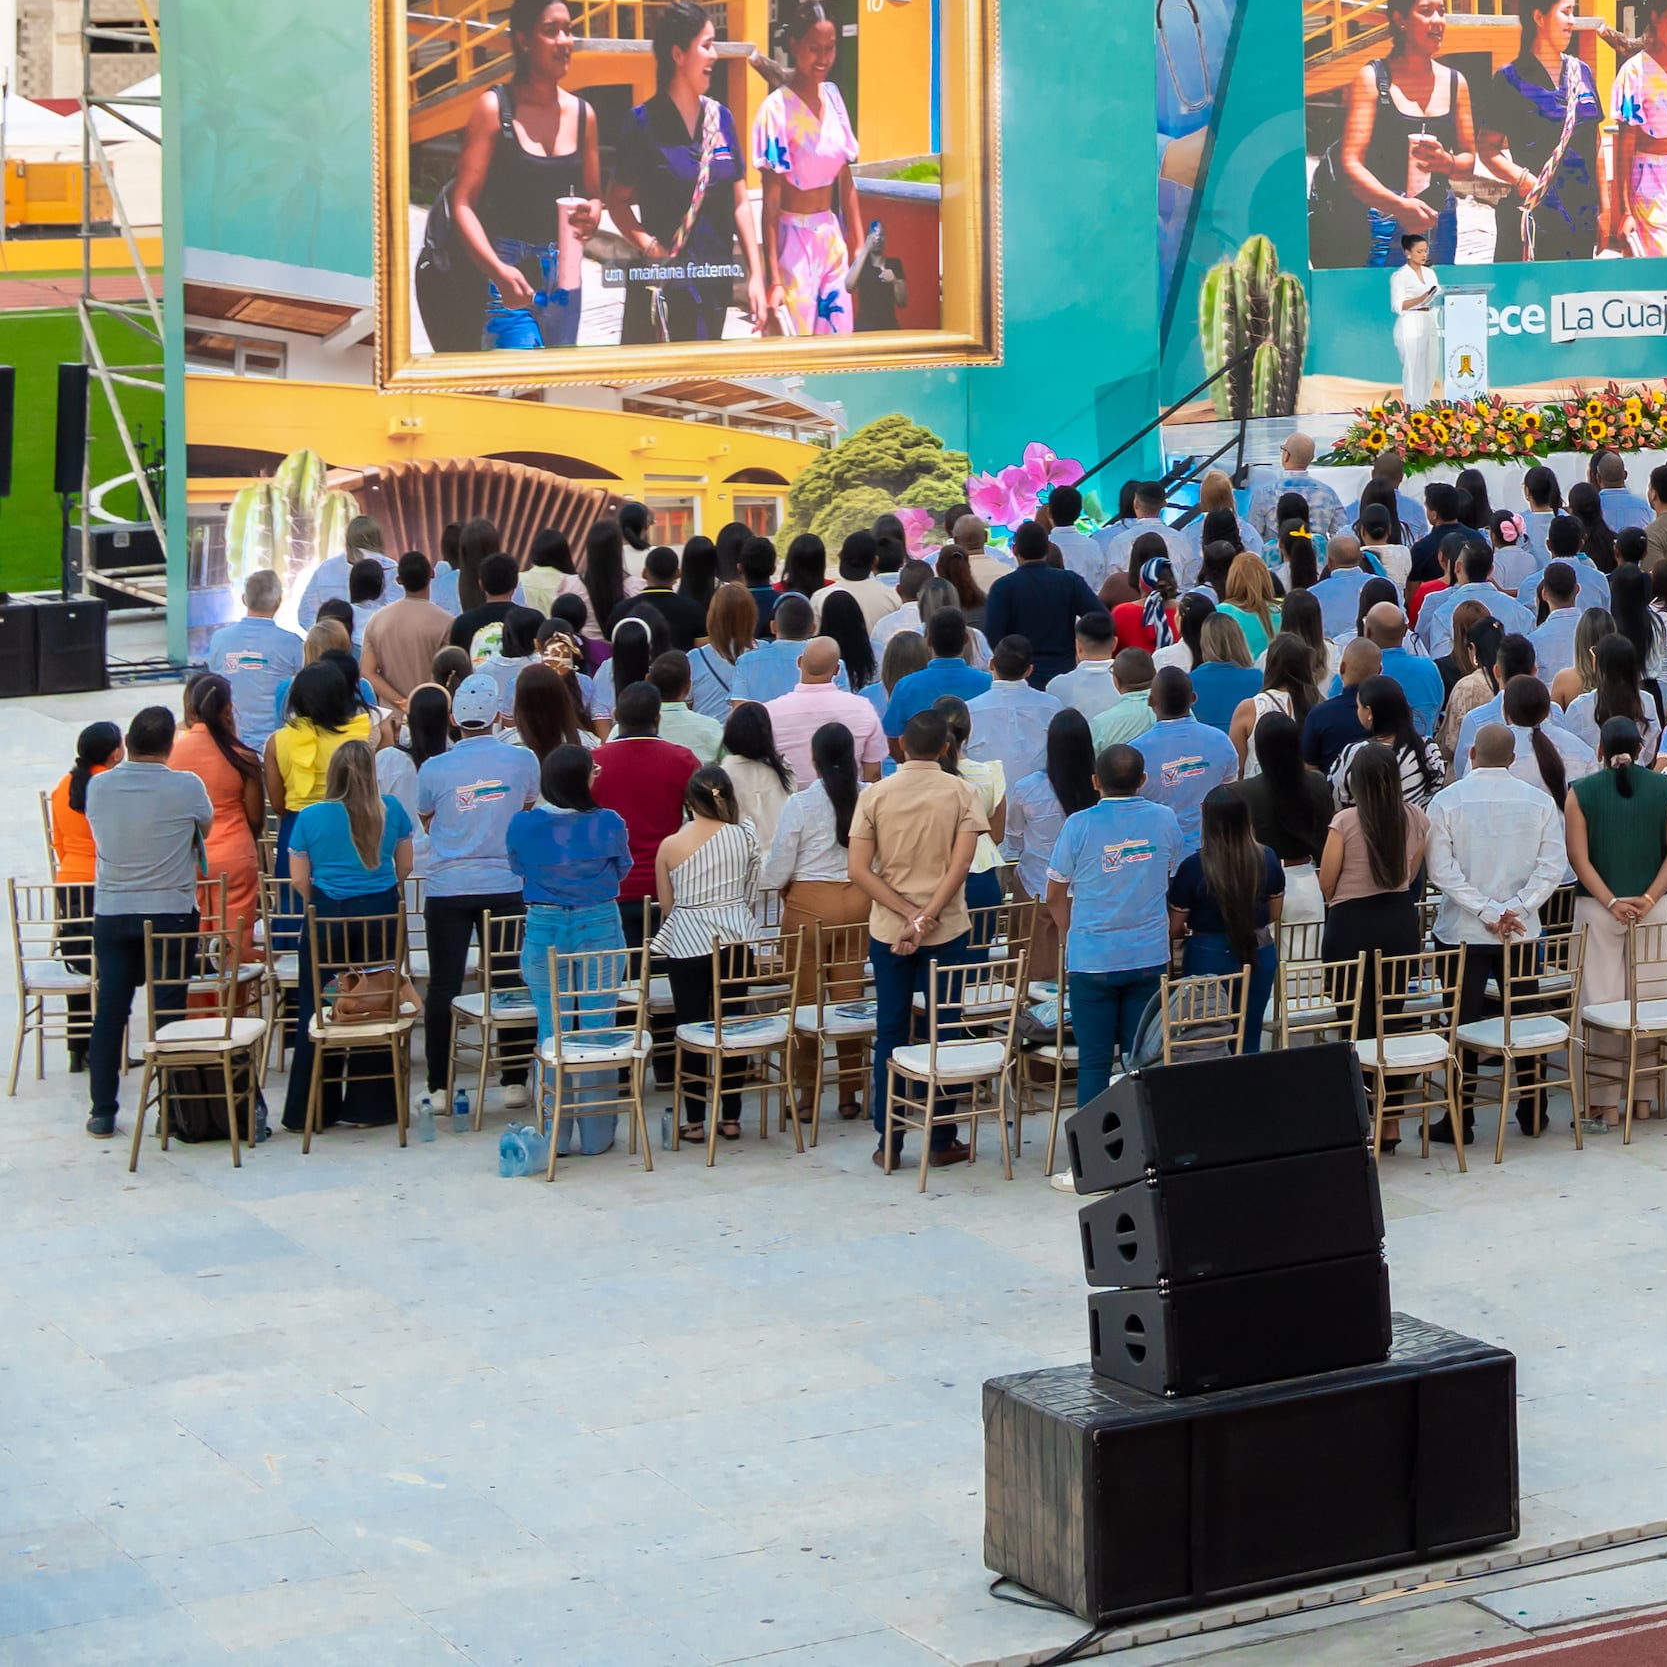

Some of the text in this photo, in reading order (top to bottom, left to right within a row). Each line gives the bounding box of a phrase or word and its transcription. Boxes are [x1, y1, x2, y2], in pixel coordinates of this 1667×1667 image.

[604, 267, 624, 281] un
[629, 264, 685, 280] mañana
[1561, 301, 1593, 331] La
